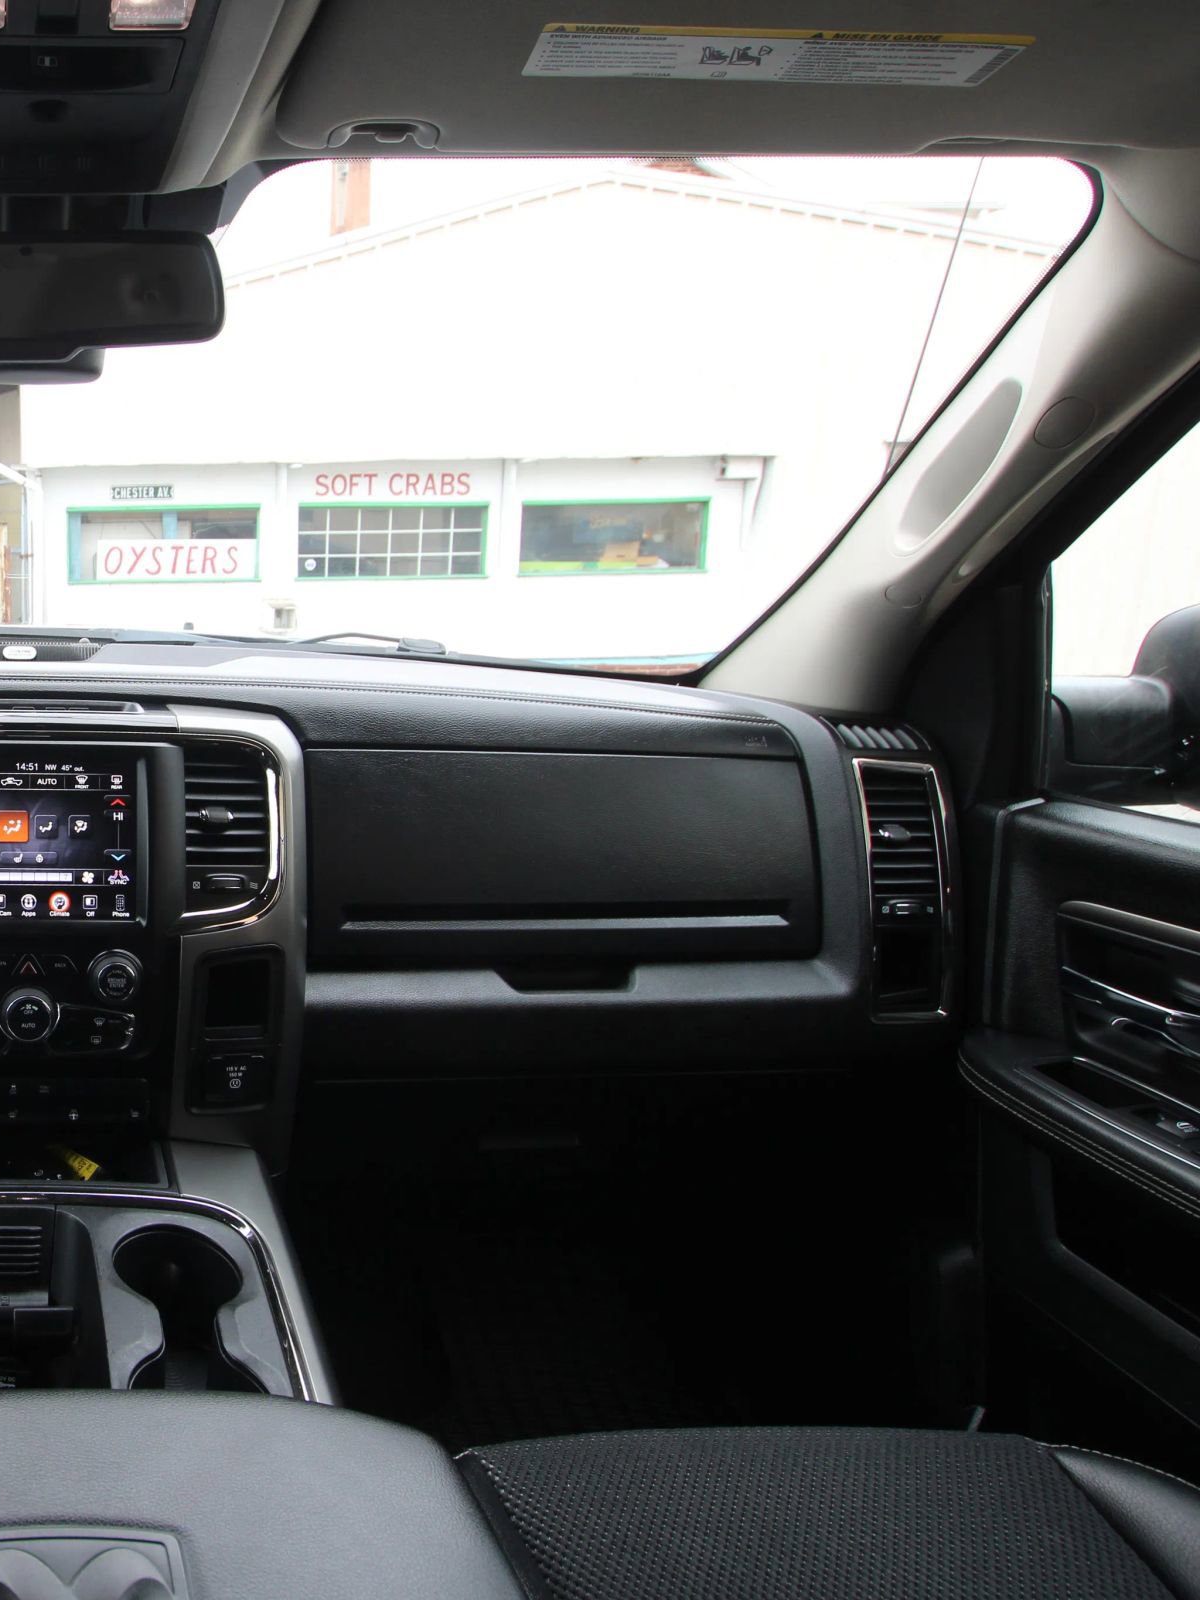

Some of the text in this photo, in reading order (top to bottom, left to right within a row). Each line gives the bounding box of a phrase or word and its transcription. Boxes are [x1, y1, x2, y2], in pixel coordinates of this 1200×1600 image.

[576, 25, 640, 34] WARNING
[315, 472, 471, 496] SOFT CRABS
[114, 486, 154, 499] CHESTER
[104, 546, 238, 576] OYSTERS
[16, 763, 38, 771] 14:51
[113, 812, 124, 821] HI
